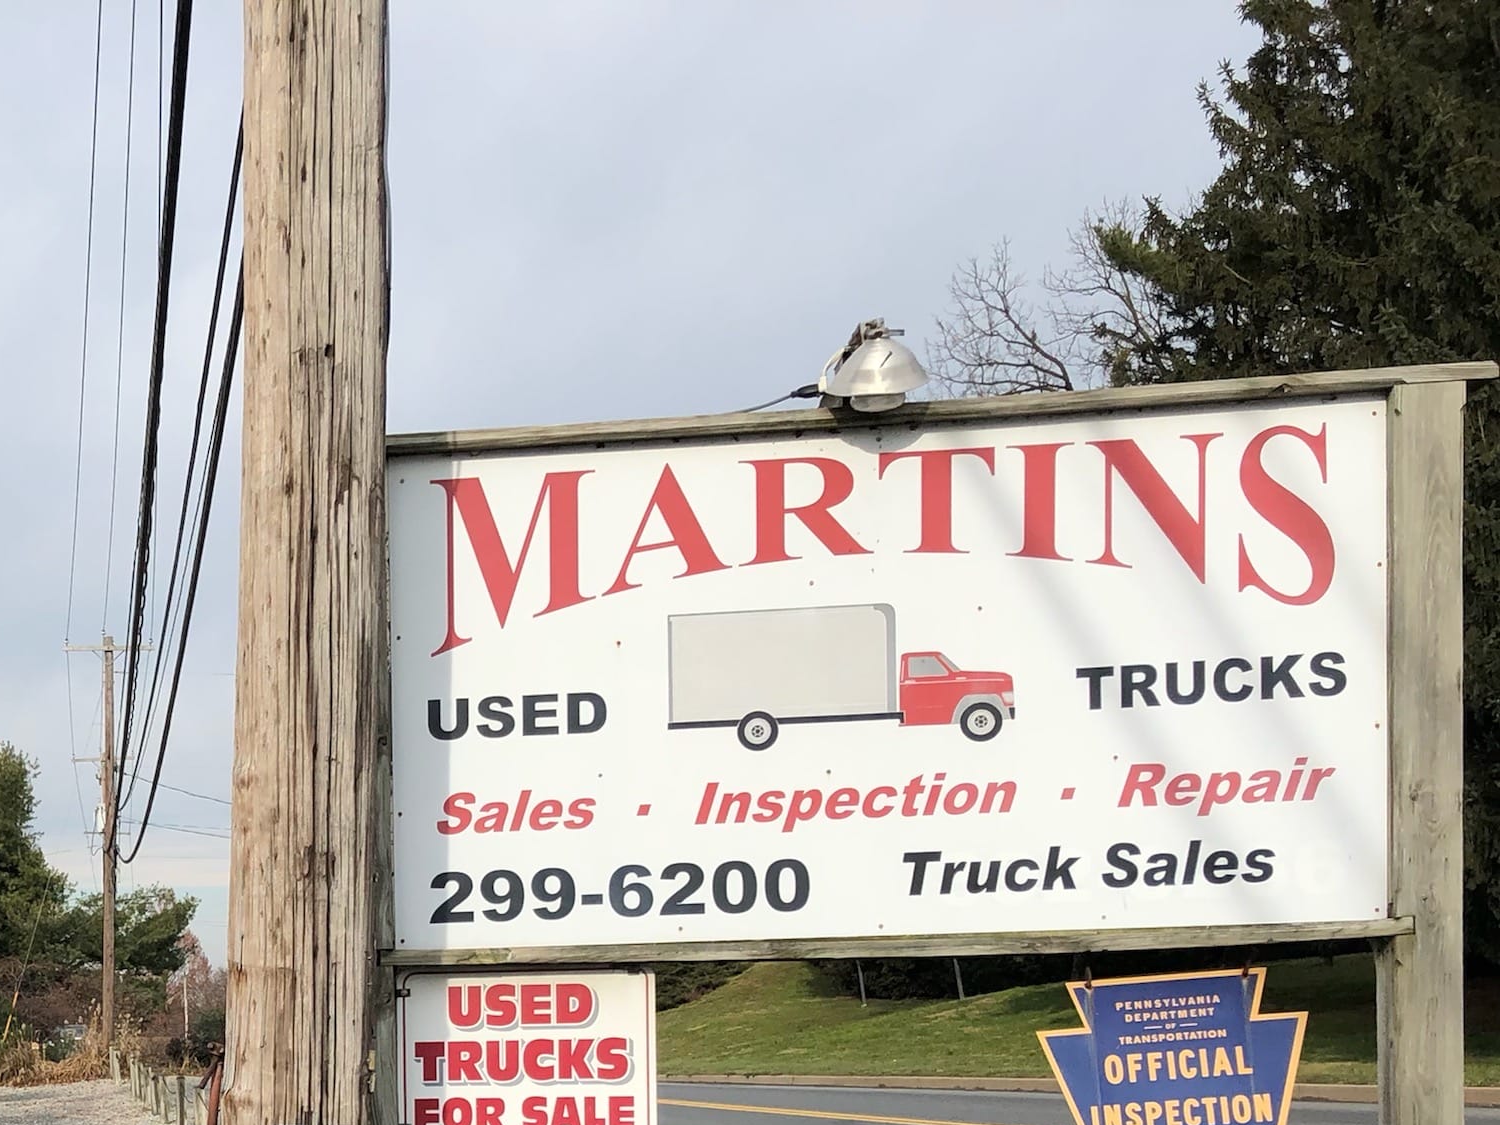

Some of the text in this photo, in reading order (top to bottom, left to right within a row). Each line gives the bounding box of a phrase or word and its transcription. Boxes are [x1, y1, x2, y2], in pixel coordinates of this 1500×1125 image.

[429, 422, 1335, 658] MARTINS
[428, 652, 1347, 740] USED TRUCKS
[436, 757, 1335, 835] Sales Inspection Repair
[429, 840, 1275, 924] 299-6200 Truck Sales
[447, 983, 593, 1027] USED
[1115, 994, 1221, 1011] PENNSYLVANIA
[1124, 1007, 1215, 1022] DEPARTMENT
[1118, 1029, 1227, 1045] TRANSPORTATION
[414, 1037, 629, 1082] TRUCKS
[1103, 1045, 1254, 1085] OFFICIAL
